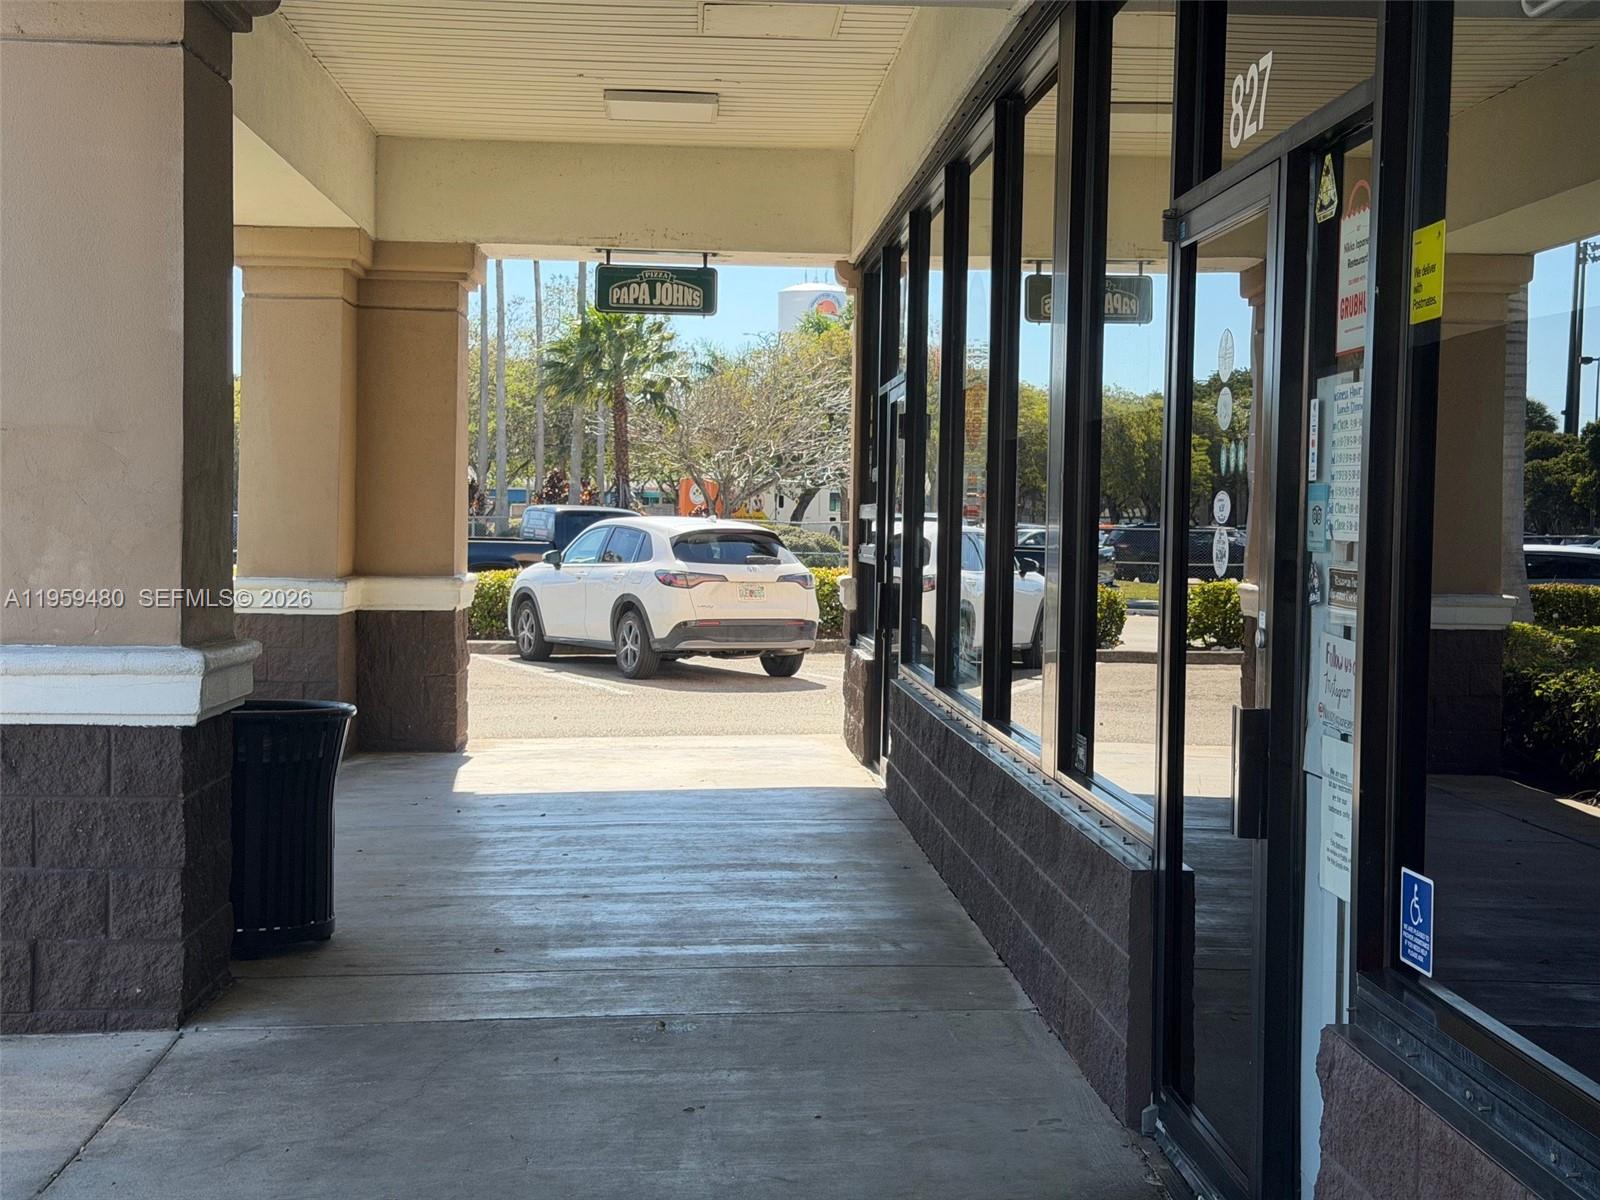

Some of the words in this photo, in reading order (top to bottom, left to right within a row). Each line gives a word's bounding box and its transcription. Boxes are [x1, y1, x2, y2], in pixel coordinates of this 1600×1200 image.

[1230, 50, 1273, 149] 827
[1422, 263, 1437, 277] deliver
[612, 282, 651, 305] PAPA
[652, 281, 701, 306] JOHNS
[1413, 282, 1423, 294] with
[1325, 642, 1343, 671] Follow
